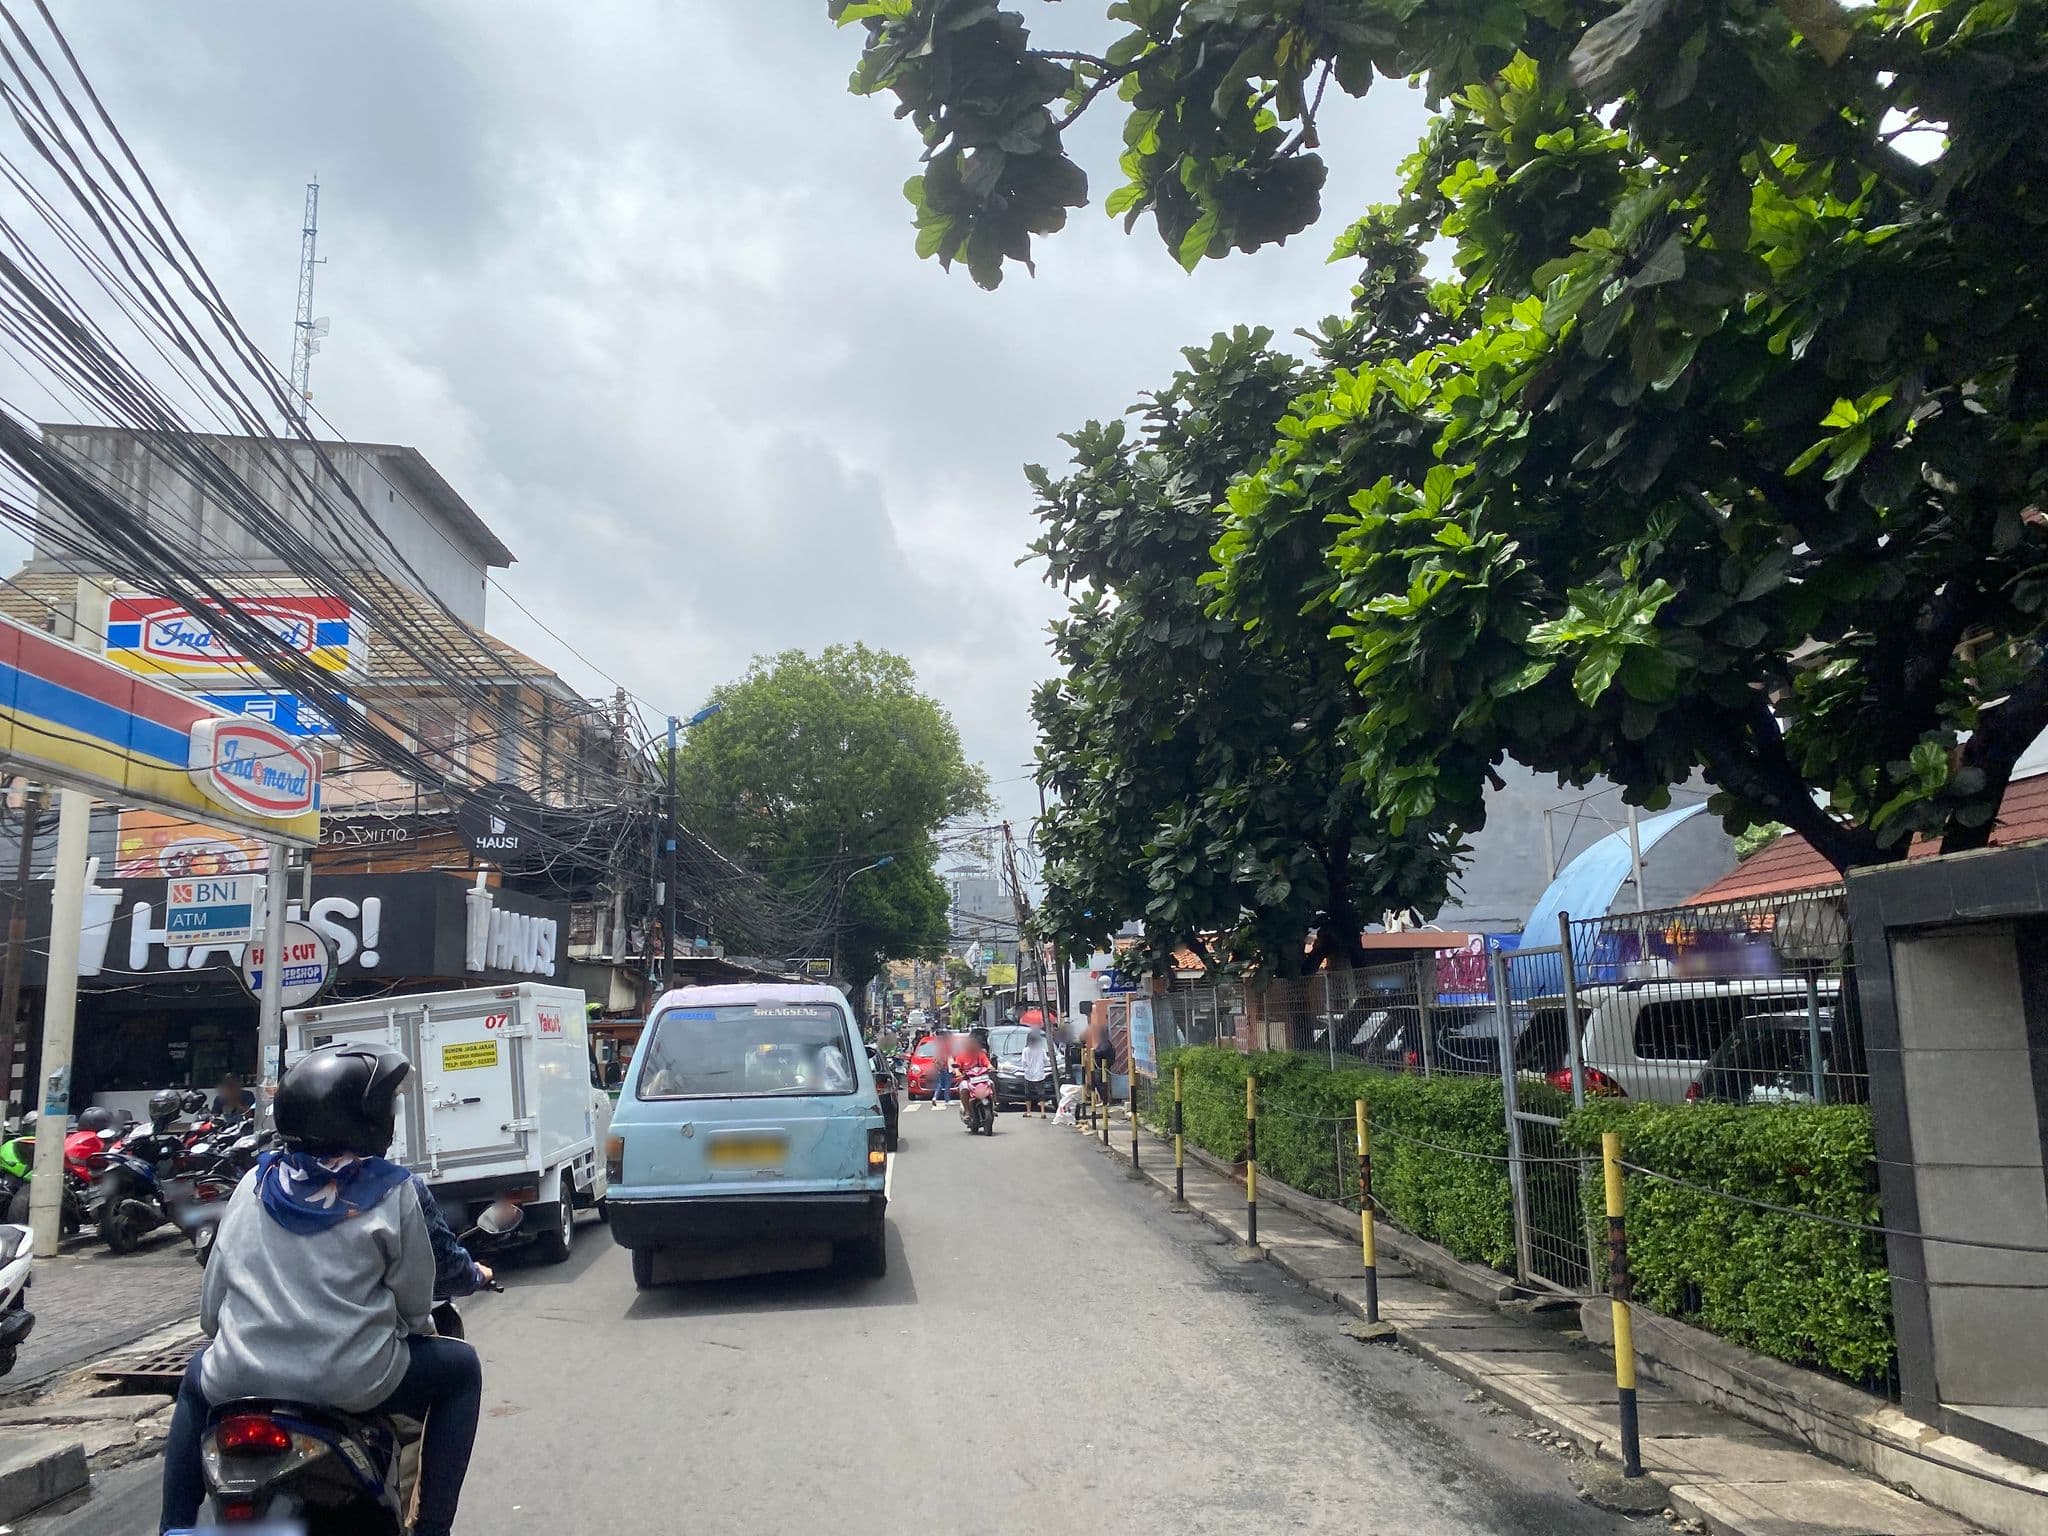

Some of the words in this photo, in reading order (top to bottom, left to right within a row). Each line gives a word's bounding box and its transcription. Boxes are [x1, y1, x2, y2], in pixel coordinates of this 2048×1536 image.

[219, 739, 306, 797] Indomaret
[476, 836, 518, 849] HAUS!
[196, 881, 237, 903] BNI
[172, 912, 208, 928] ATM
[292, 943, 316, 961] CUT
[484, 1014, 507, 1030] 07
[538, 1012, 561, 1033] Yakult
